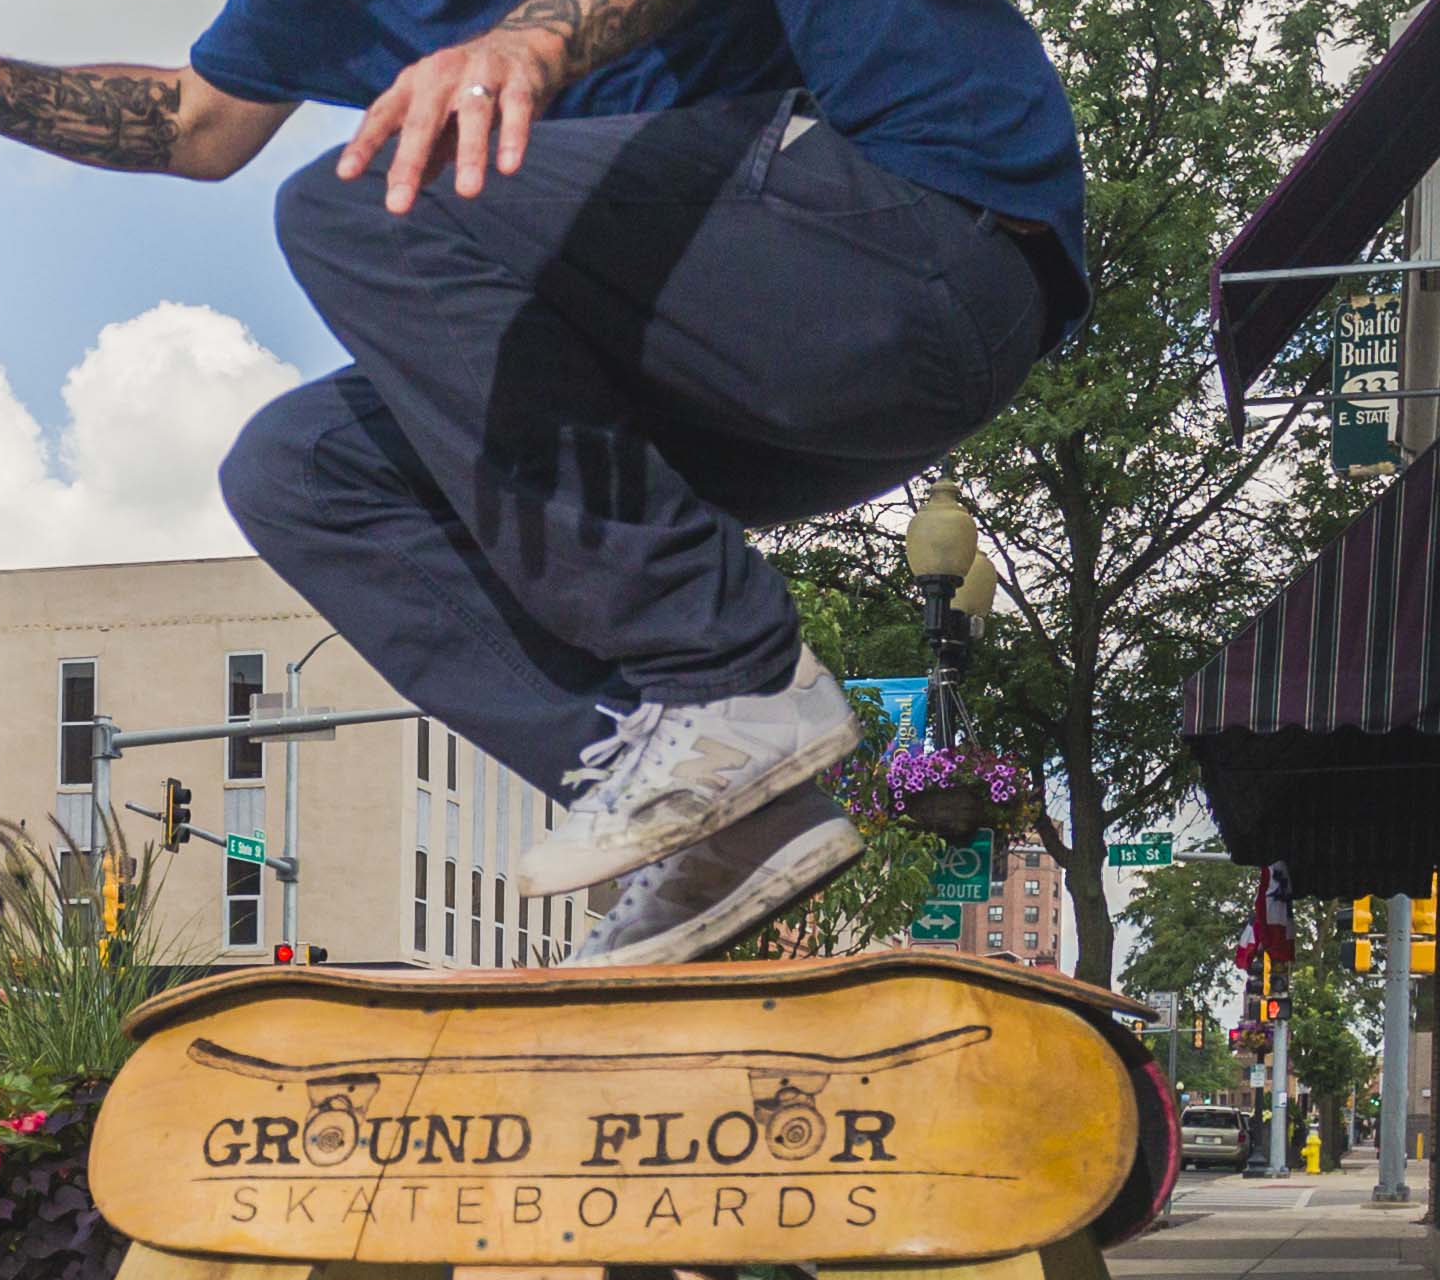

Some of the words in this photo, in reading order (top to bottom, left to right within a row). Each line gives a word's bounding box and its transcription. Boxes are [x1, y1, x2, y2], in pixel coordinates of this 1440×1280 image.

[1121, 849, 1136, 861] 1st
[1146, 848, 1160, 860] St
[937, 883, 982, 899] ROUTE
[203, 1109, 533, 1167] GROUND
[580, 1103, 898, 1166] FLOOR
[231, 1185, 878, 1228] SKATEBOARDS
